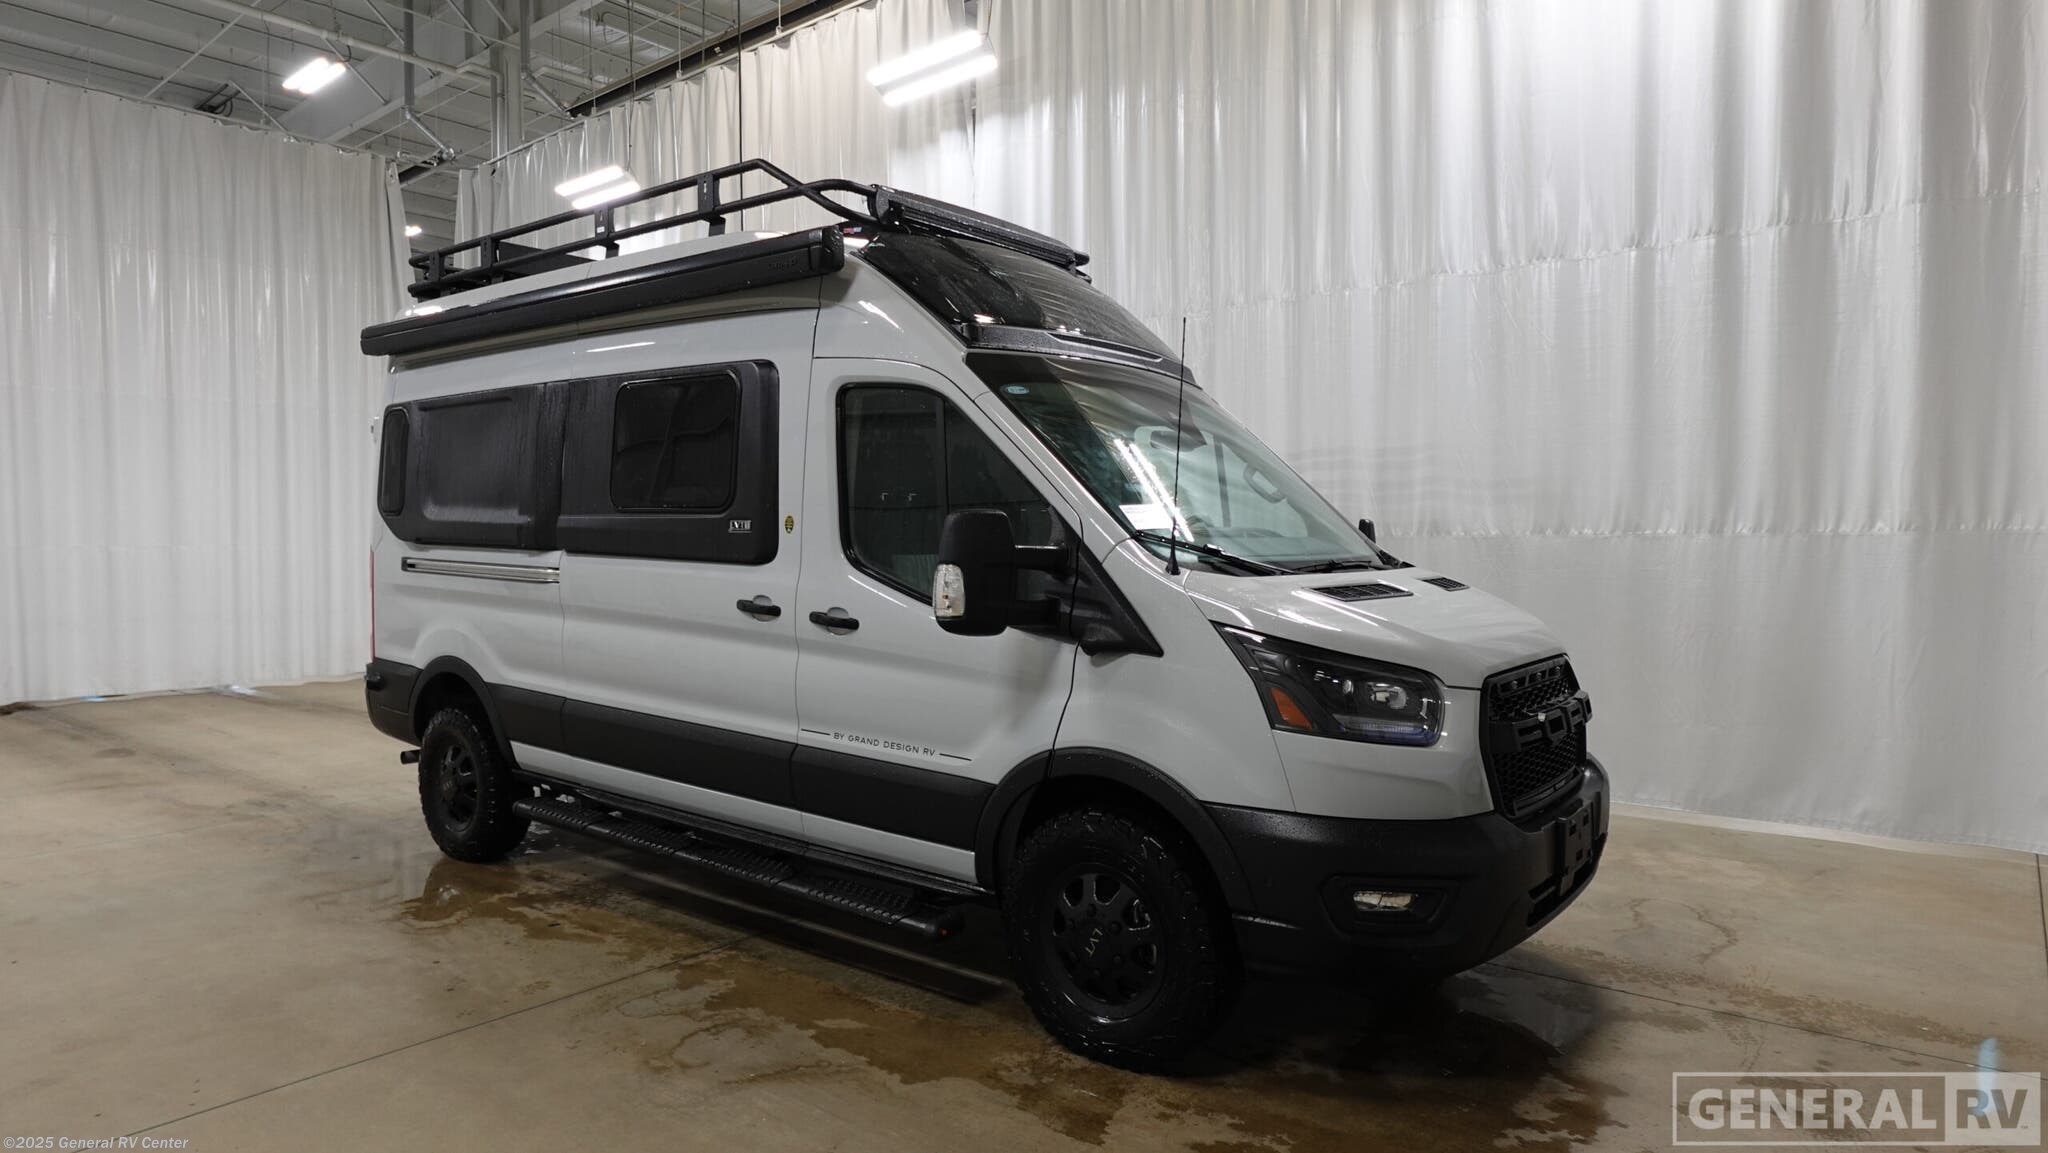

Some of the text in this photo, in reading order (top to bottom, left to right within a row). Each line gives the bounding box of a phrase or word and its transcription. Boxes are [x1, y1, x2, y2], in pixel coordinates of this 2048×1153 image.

[833, 732, 936, 757] BY GRAND DESIGN RV
